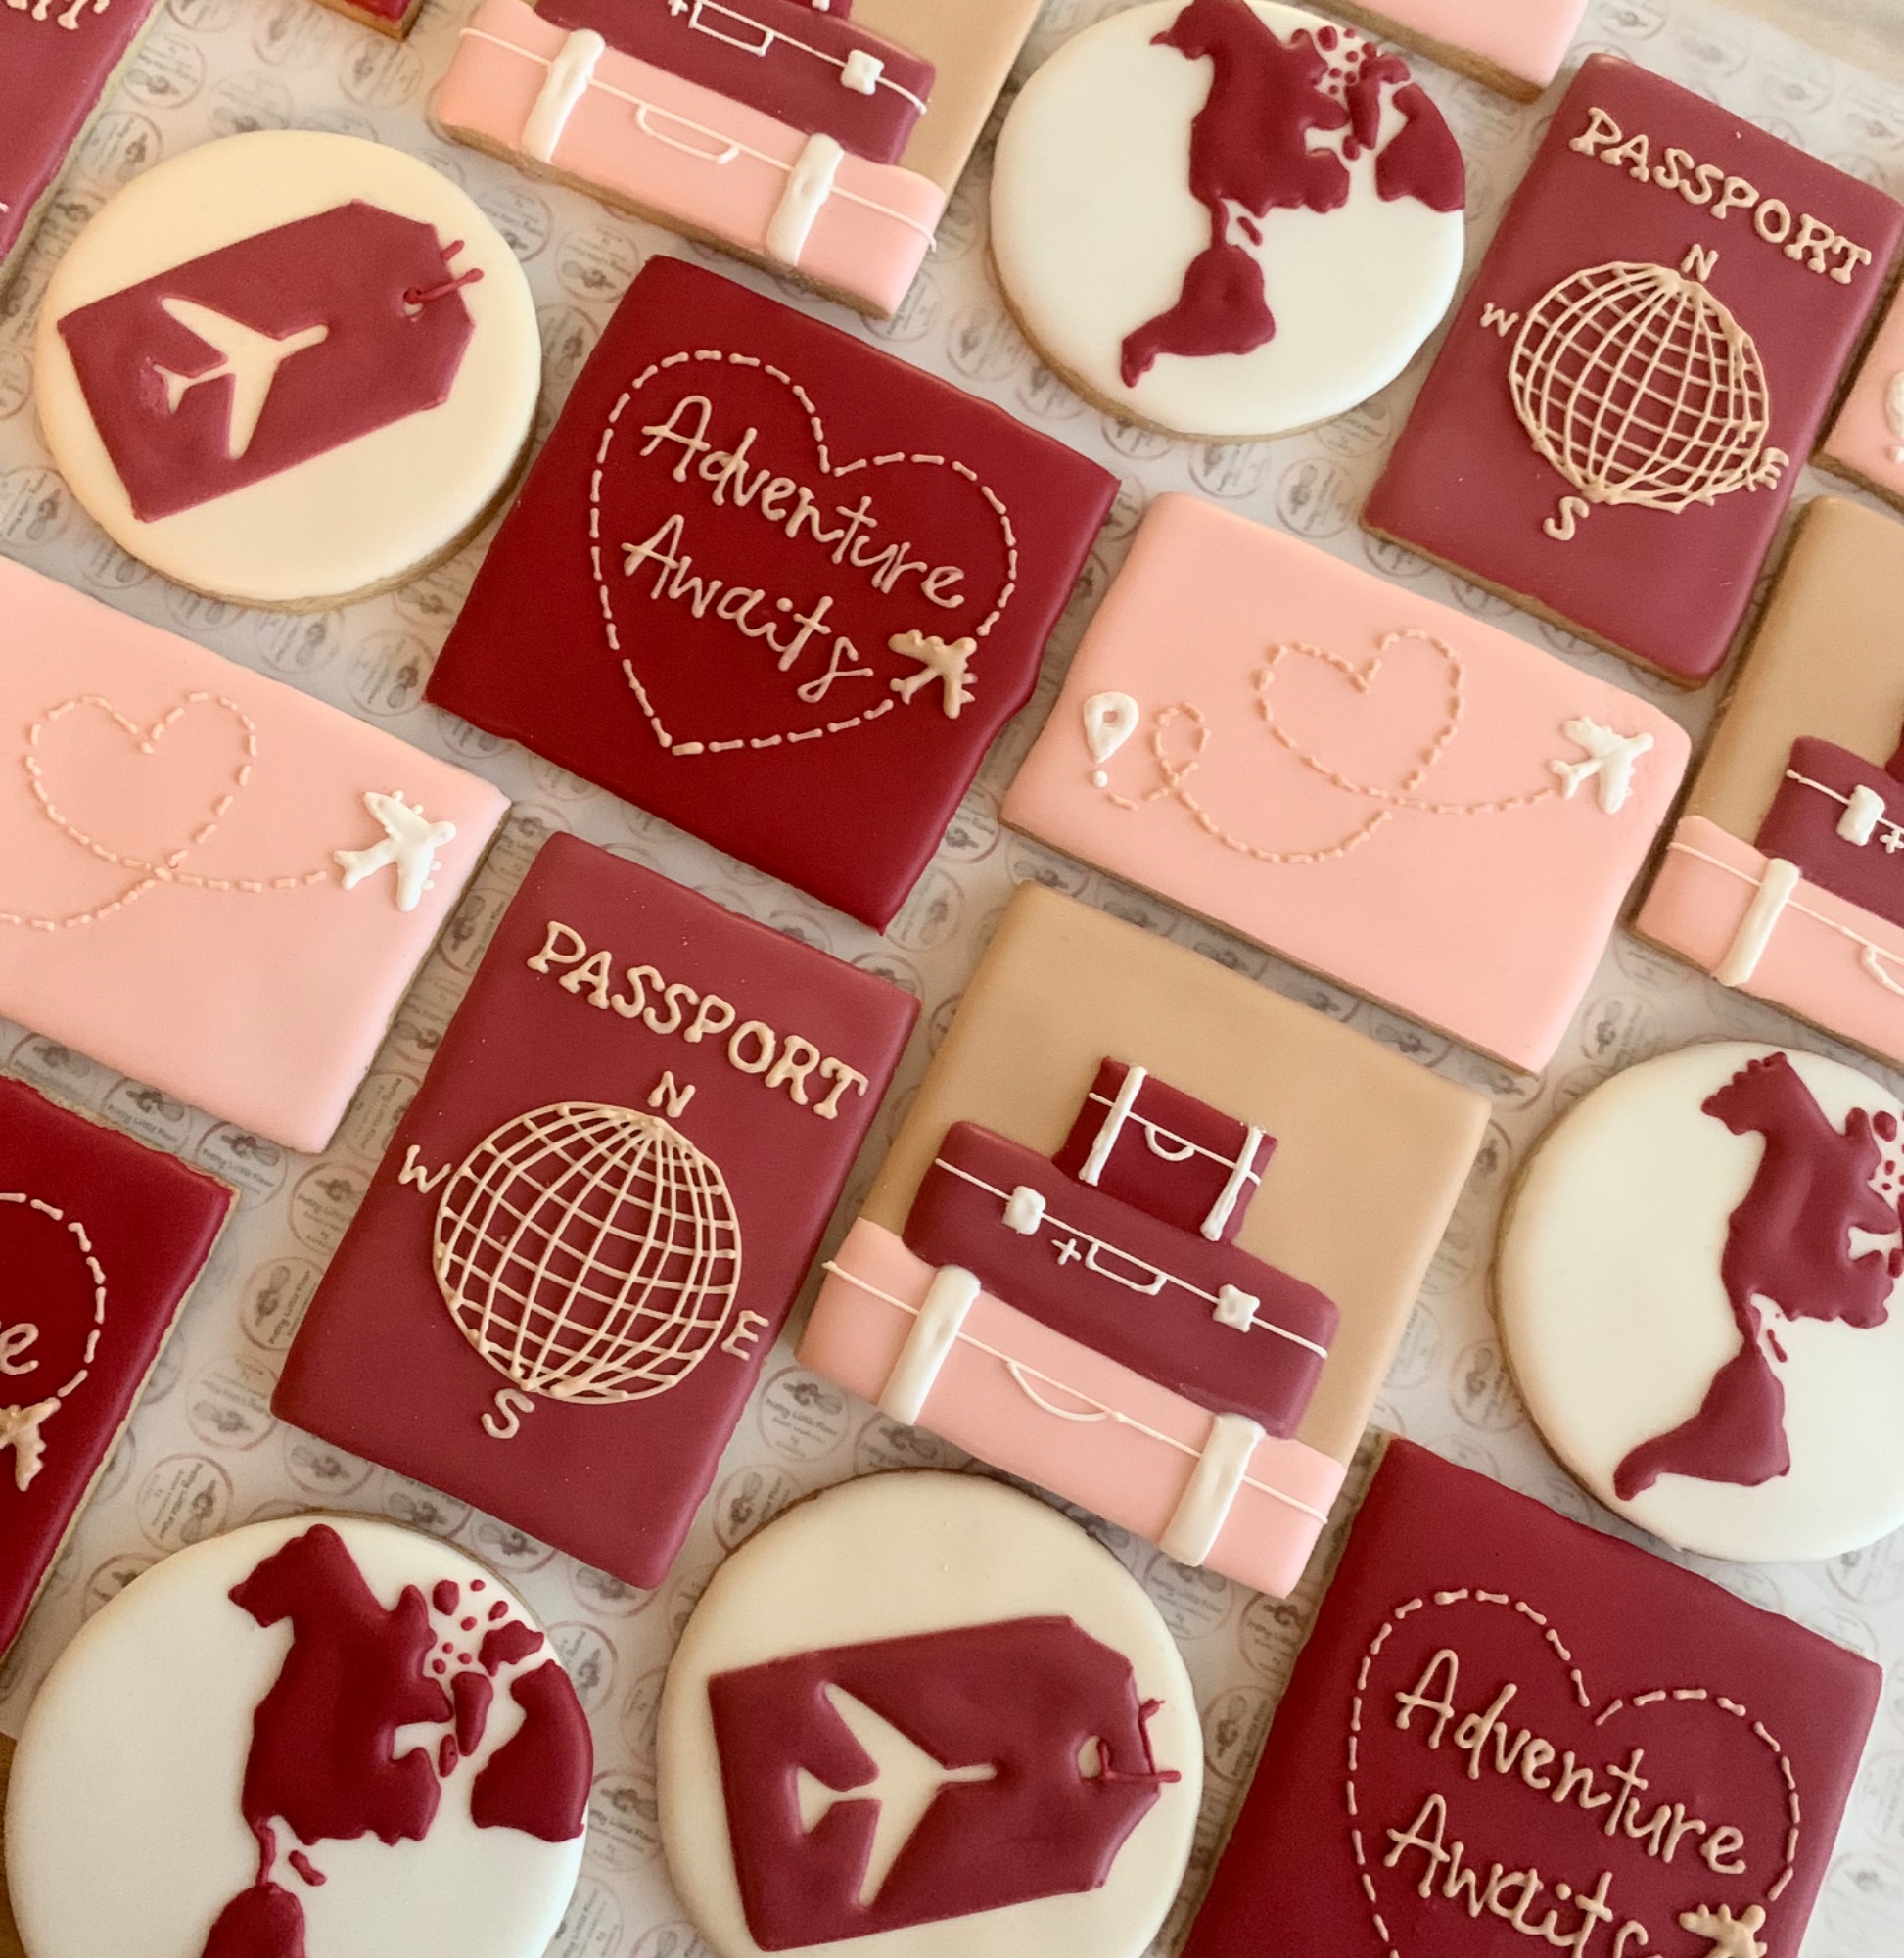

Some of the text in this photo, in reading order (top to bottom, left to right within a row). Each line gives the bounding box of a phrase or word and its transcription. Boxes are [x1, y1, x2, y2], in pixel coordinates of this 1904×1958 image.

[1569, 107, 1871, 284] PASSPORT
[1682, 244, 1719, 282] N
[1480, 303, 1519, 338] W
[640, 395, 964, 608] Adventure
[1543, 496, 1590, 540] S
[622, 514, 874, 703] Awaits
[527, 920, 869, 1120] PASSPORT
[647, 1070, 696, 1118] N
[398, 1144, 451, 1193] W
[720, 1310, 769, 1361] E
[481, 1388, 535, 1439] S
[1394, 1649, 1746, 1874] Adventure
